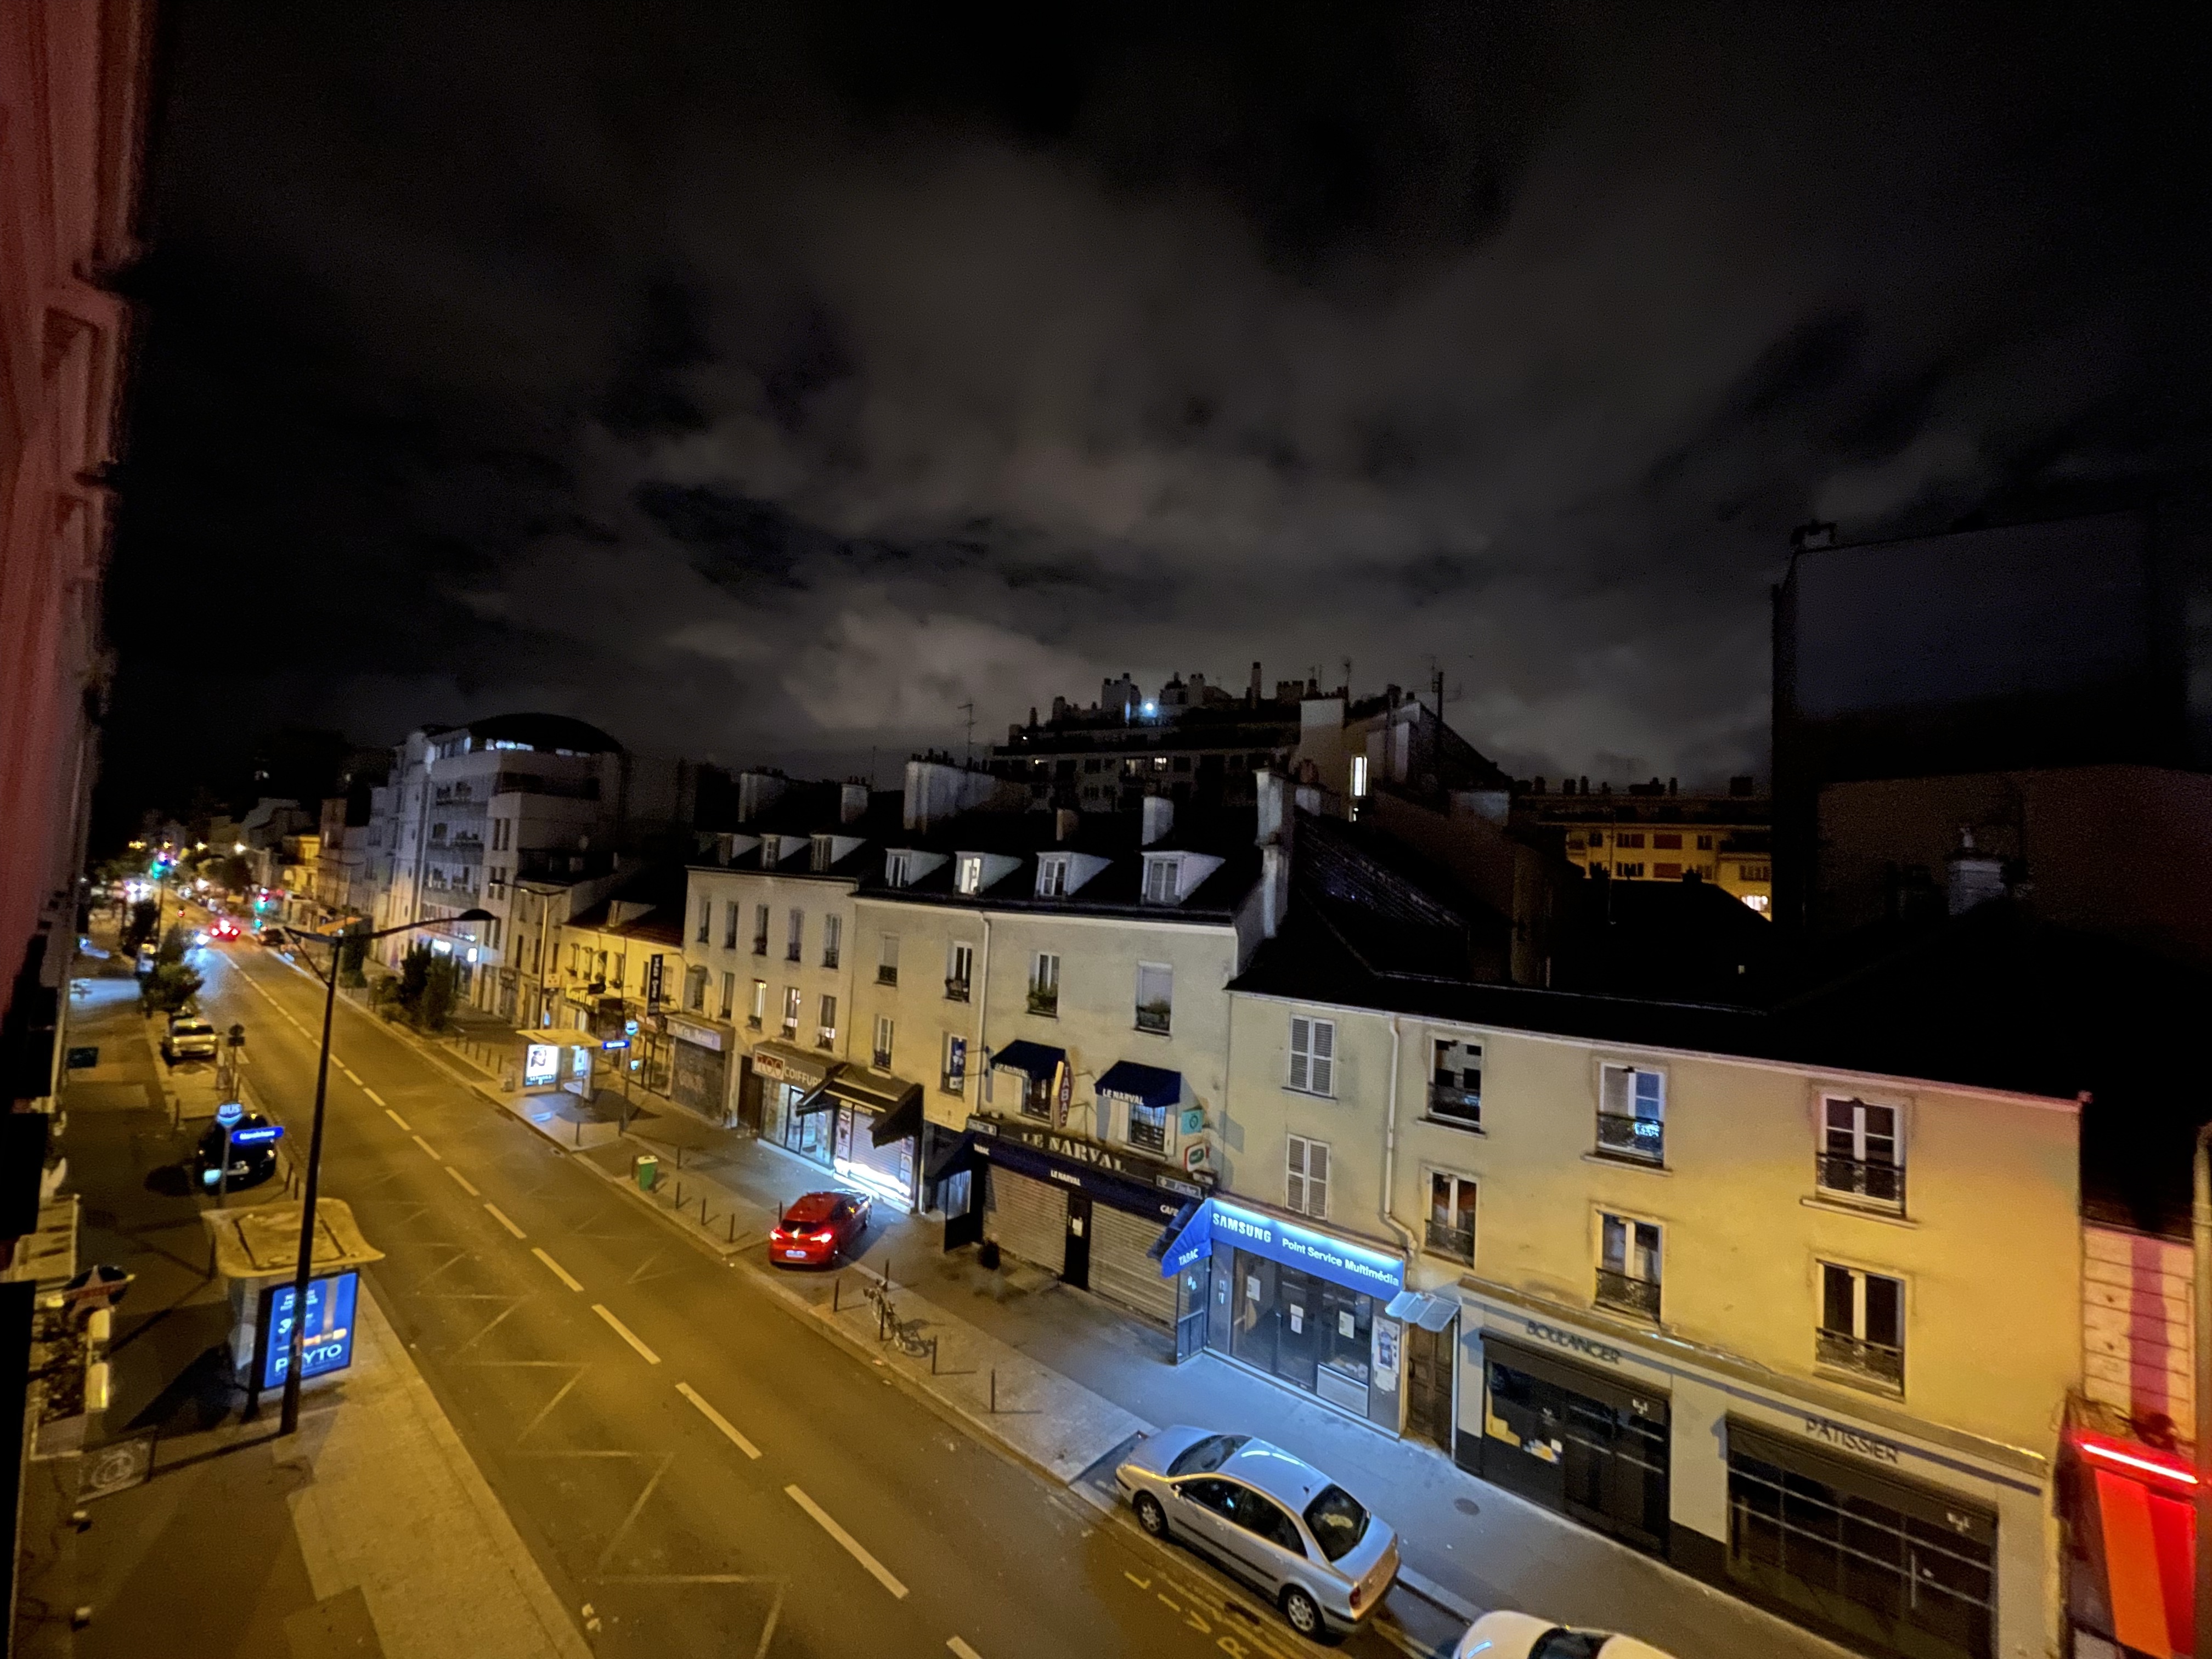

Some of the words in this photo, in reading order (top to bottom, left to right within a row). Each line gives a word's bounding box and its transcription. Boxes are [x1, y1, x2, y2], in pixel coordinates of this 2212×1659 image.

[784, 1066, 822, 1087] COIFFUR
[1061, 1067, 1070, 1123] TABAC
[1103, 1088, 1111, 1098] LE
[1113, 1091, 1144, 1105] NARVAL
[219, 1104, 241, 1115] BUS
[1022, 1132, 1043, 1148] LE
[1049, 1137, 1127, 1172] NARVAL
[1051, 1169, 1058, 1178] LE
[1058, 1171, 1081, 1186] NARVAL
[1178, 1248, 1199, 1266] TABAC
[1212, 1213, 1272, 1243] SAMSUNG
[1282, 1238, 1306, 1254] Point
[1307, 1246, 1342, 1267] Service
[1345, 1259, 1399, 1286] Multimédia
[1527, 1321, 1620, 1364] BOULANGER
[275, 1344, 342, 1373] PYTO
